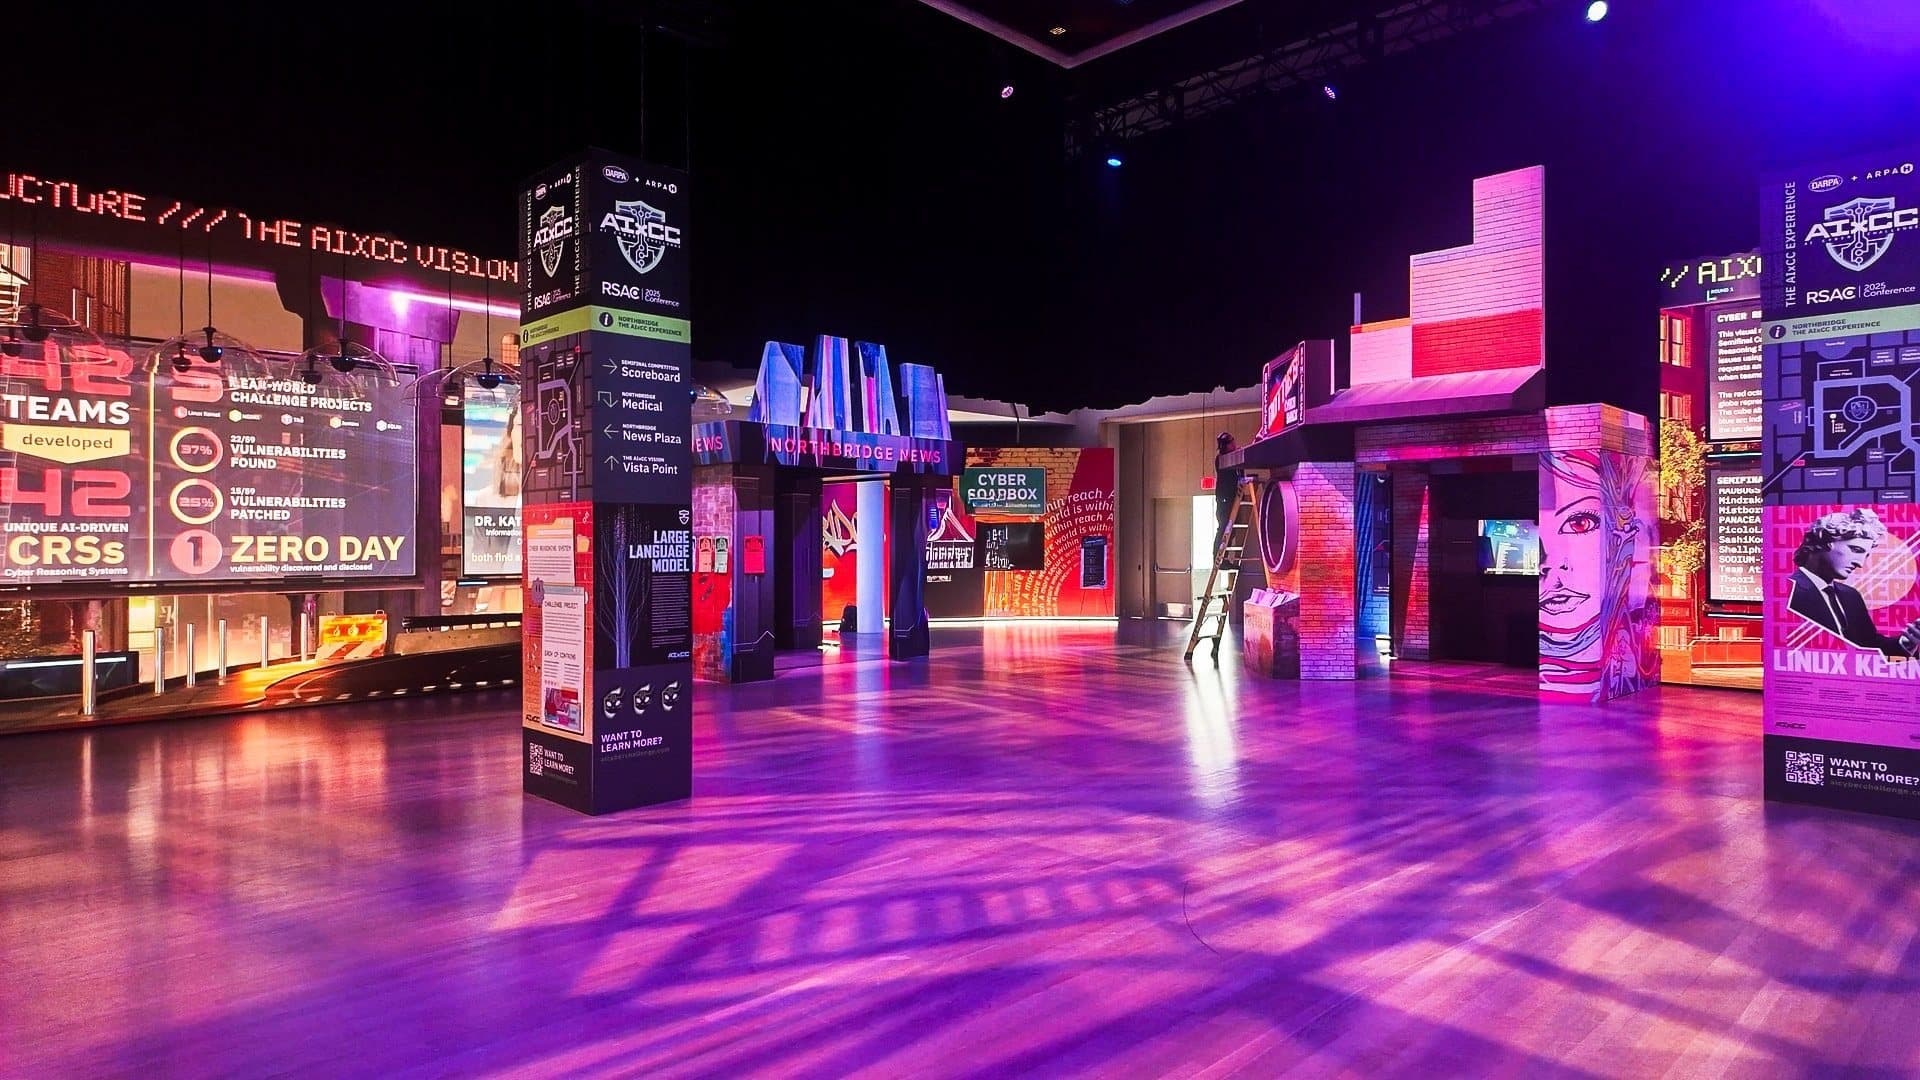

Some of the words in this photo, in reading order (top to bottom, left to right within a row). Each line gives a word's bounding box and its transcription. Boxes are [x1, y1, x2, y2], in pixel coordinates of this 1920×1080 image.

[1811, 178, 1840, 190] DARPA
[1785, 181, 1796, 249] EXPERIENCE
[600, 213, 680, 245] AIxCC
[1804, 207, 1919, 242] AIxCC
[534, 216, 573, 249] AIxCC
[311, 226, 408, 264] AIXCC
[1785, 251, 1796, 284] AIxCC
[602, 281, 640, 300] RSAC
[1863, 282, 1886, 291] 2025
[1863, 285, 1916, 298] Conference
[644, 295, 680, 307] Conference
[1785, 286, 1796, 308] THE
[1806, 286, 1856, 305] RSAC
[618, 316, 659, 327] NORTHBRIDGE
[618, 322, 631, 330] THE
[1792, 319, 1847, 330] NORTHBRIDGE
[1832, 321, 1881, 332] EXPERIENCE
[1718, 330, 1734, 338] This
[1718, 346, 1757, 355] Reasoning
[621, 366, 681, 383] Scoreboard
[2, 393, 130, 425] TEAMS
[230, 391, 307, 408] CHALLENGE
[311, 397, 373, 413] PROJECTS
[622, 398, 663, 412] Medical
[22, 433, 113, 450] developed
[623, 430, 652, 442] News
[654, 432, 682, 444] Plaza
[692, 435, 723, 452] EWS
[181, 445, 213, 456] 37%
[230, 443, 347, 460] VULNERABILITIES
[771, 437, 894, 462] NORTHBRIDGE
[899, 448, 942, 464] NEWS
[230, 457, 277, 469] FOUND
[623, 462, 650, 474] Vista
[652, 463, 678, 475] Point
[978, 473, 1026, 486] CYBER
[0, 467, 131, 517] 42
[1067, 487, 1103, 504] reach
[178, 497, 215, 508] 25%
[230, 496, 347, 509] VULNERABILITIES
[1073, 503, 1083, 514] is
[230, 509, 291, 521] PATCHED
[474, 515, 496, 527] DR.
[1075, 511, 1103, 526] reach
[1718, 515, 1761, 524] PANACEA
[4, 522, 58, 533] UNIQUE
[60, 522, 129, 533] AI-DRIVEN
[653, 530, 689, 544] LARGE
[8, 535, 125, 566] CRSs
[186, 536, 204, 567] 1
[230, 535, 330, 563] ZERO
[339, 535, 406, 562] DAY
[629, 544, 690, 559] LANGUAGE
[471, 552, 493, 562] both
[36, 566, 88, 577] Reasoning
[88, 566, 129, 576] Systems
[230, 564, 280, 574] vulnerability
[323, 563, 338, 571] and
[651, 558, 690, 573] MODEL
[1773, 649, 1849, 676] LINUX
[601, 731, 628, 743] WANT
[630, 730, 642, 739] TO
[601, 740, 631, 753] LEARN
[633, 736, 663, 749] MORE?
[1829, 757, 1868, 770] WANT
[1870, 762, 1888, 772] TO
[1829, 767, 1871, 780] LEARN
[1874, 772, 1920, 786] MORE?
